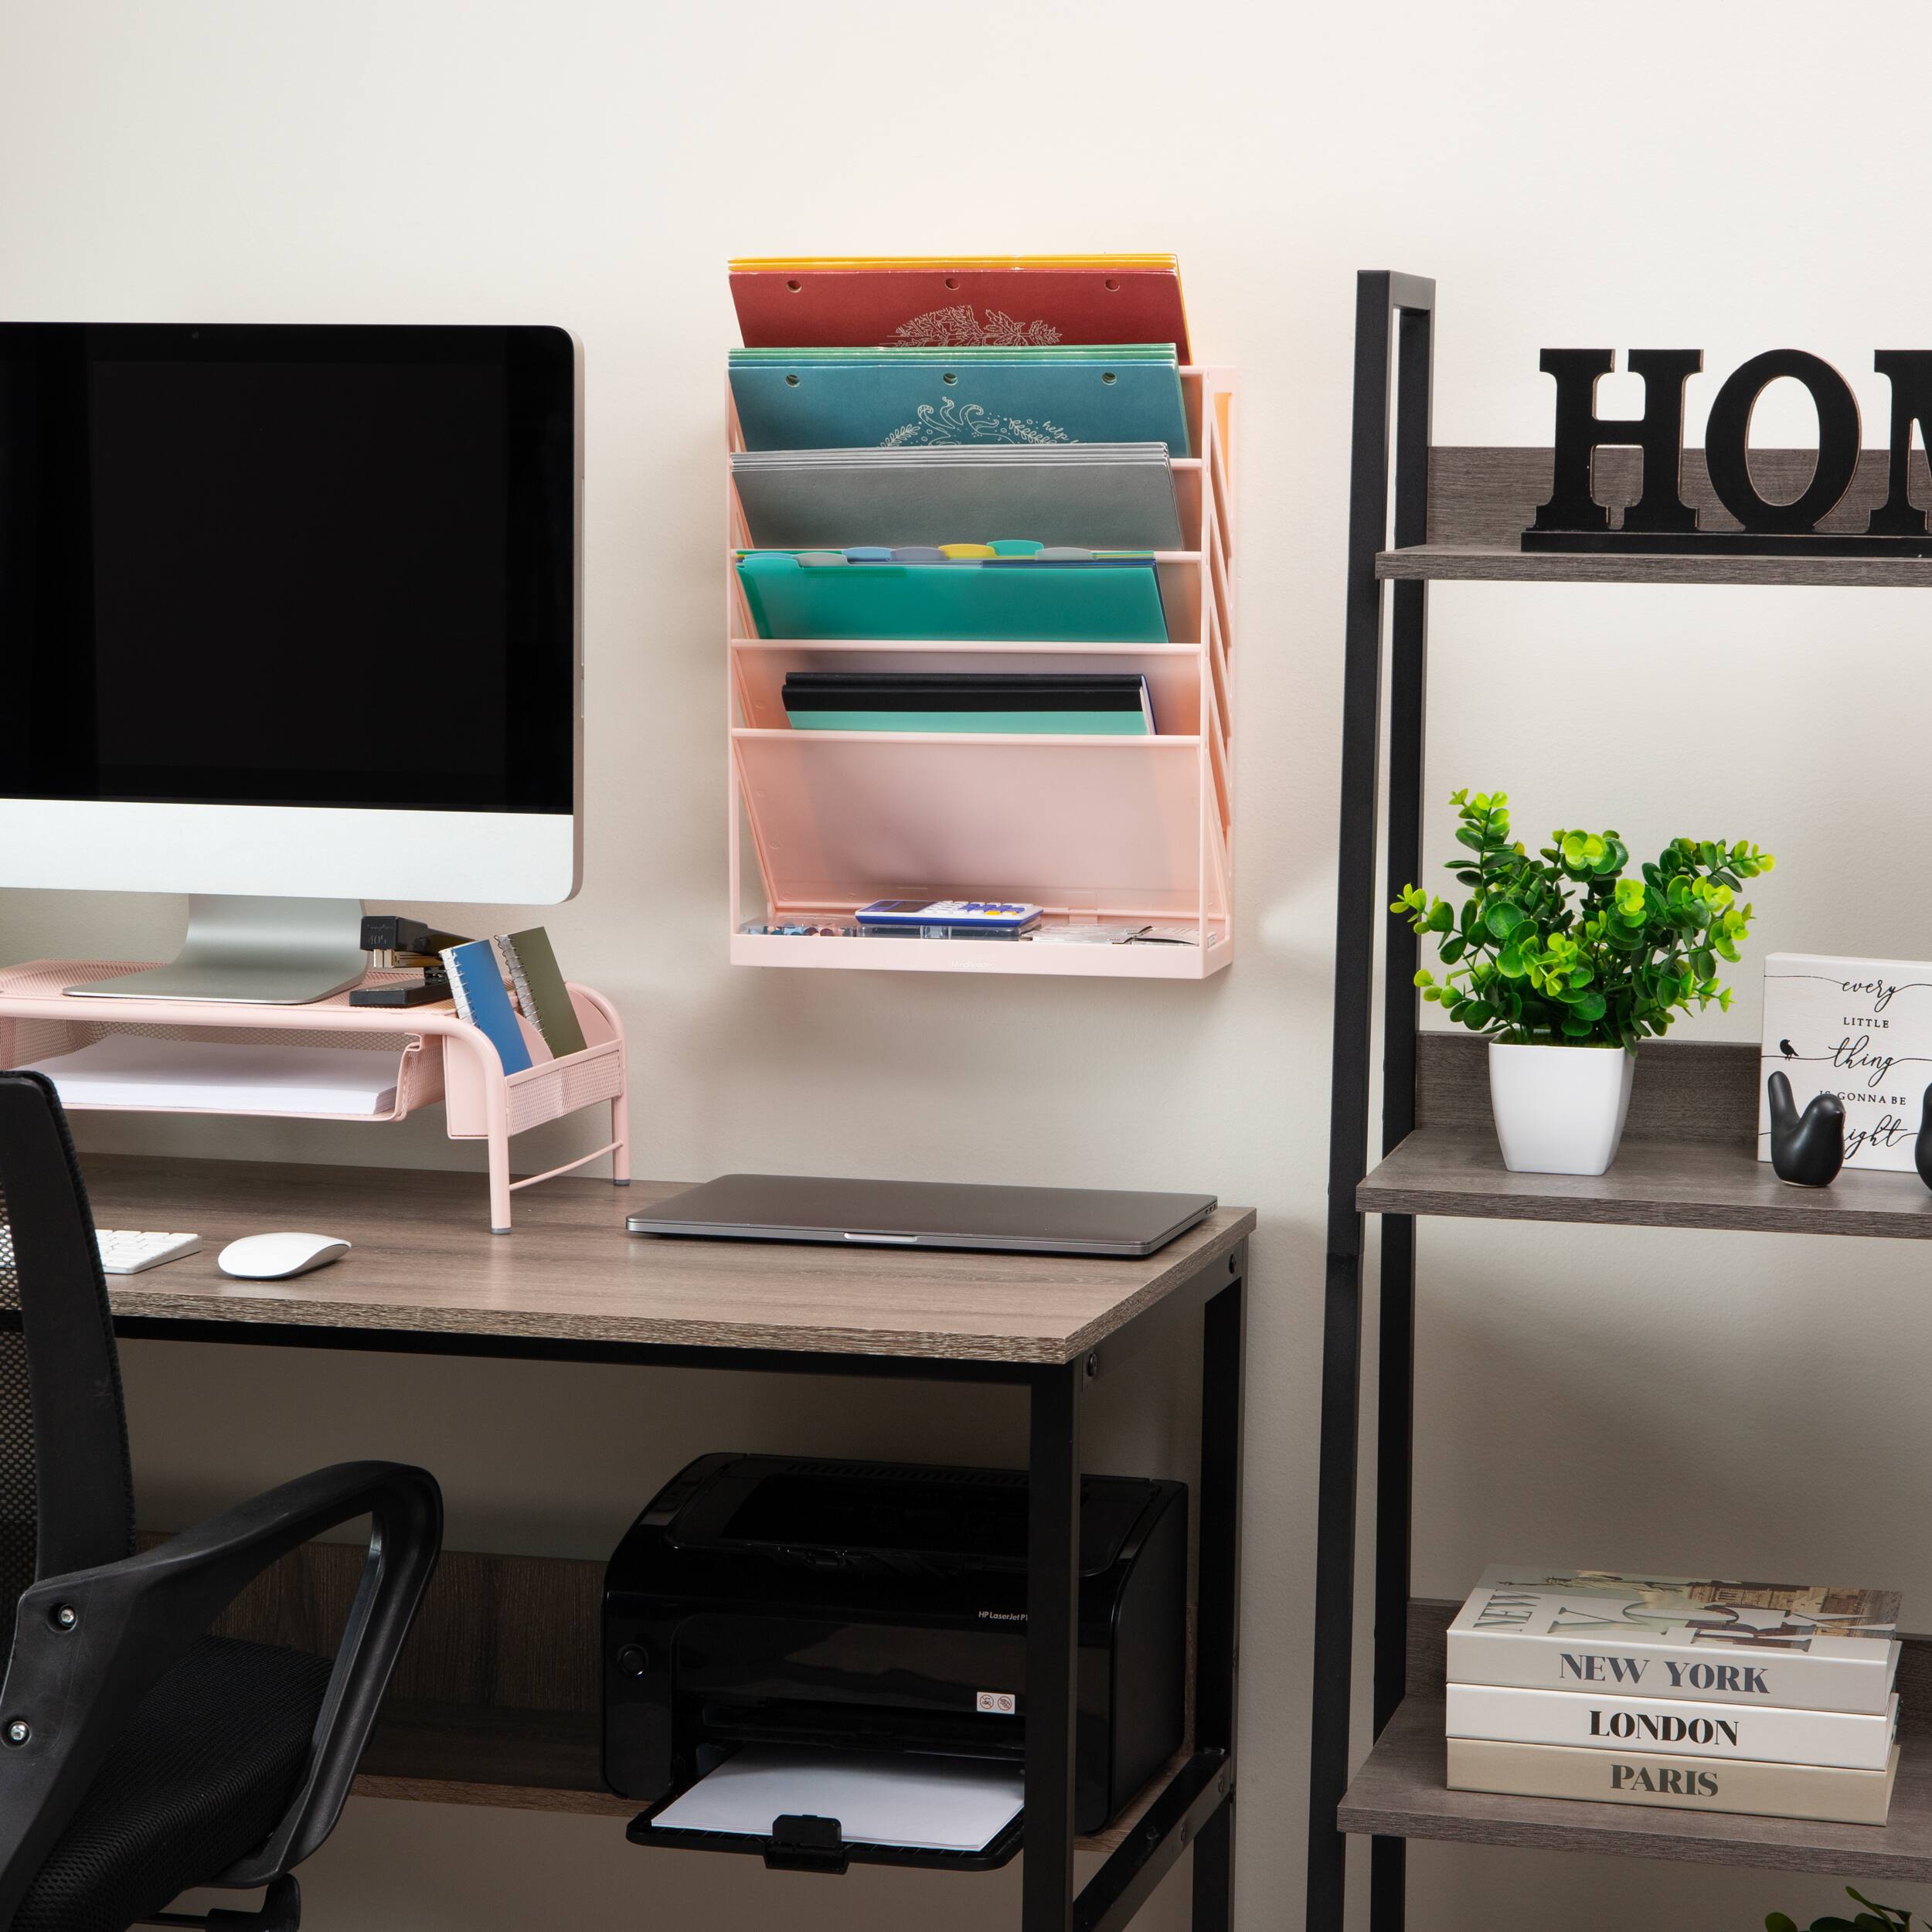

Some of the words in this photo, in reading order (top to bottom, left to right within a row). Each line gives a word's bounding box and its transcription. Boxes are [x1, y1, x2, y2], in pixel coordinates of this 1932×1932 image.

[1842, 979, 1896, 1012] every
[1843, 1016, 1889, 1029] LITTLE
[1828, 1035, 1894, 1087] thing
[1837, 1091, 1886, 1104] GONNA
[1891, 1096, 1906, 1105] BE
[1844, 1114, 1908, 1159] ight
[990, 1611, 1020, 1621] LaserJet
[1560, 1653, 1651, 1684] NEW
[1664, 1661, 1770, 1694] YORK
[1589, 1710, 1740, 1747] LONDON
[1610, 1764, 1719, 1797] PARIS
